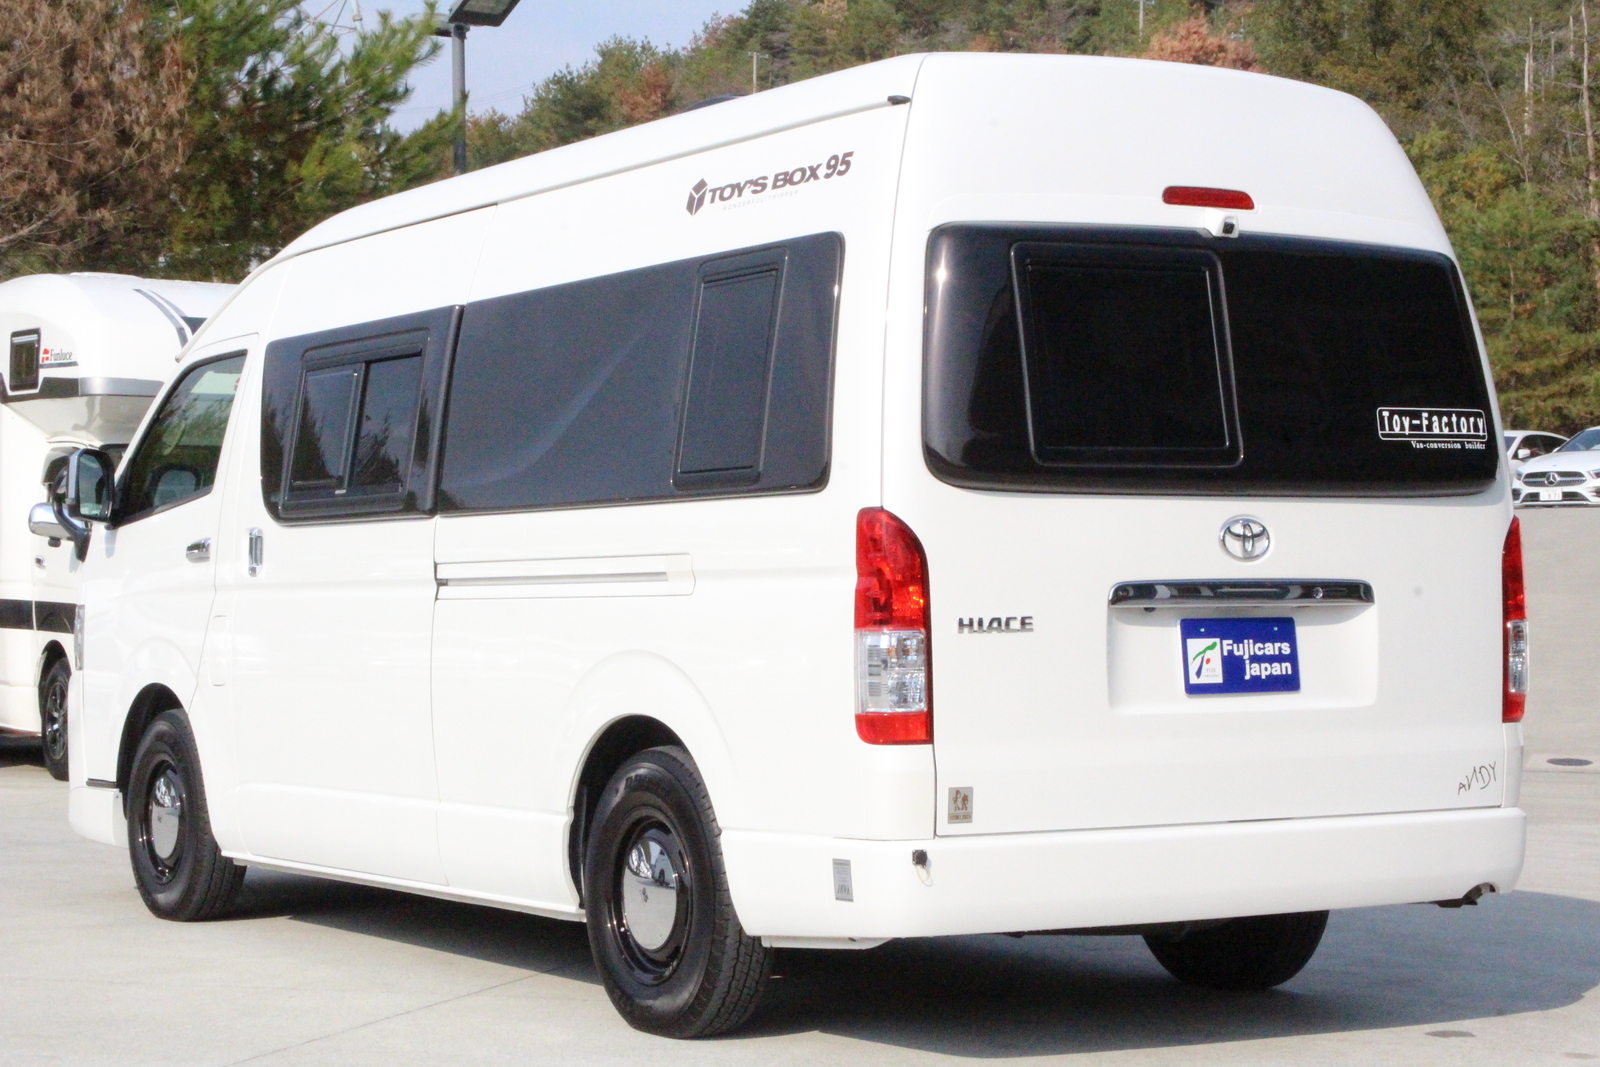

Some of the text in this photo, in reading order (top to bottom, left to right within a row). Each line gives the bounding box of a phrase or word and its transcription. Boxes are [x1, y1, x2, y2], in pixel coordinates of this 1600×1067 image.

[708, 150, 855, 205] TOY'S BOX 95
[1382, 411, 1484, 436] Toy-Factory
[1411, 440, 1486, 450] Van-conversion builder
[957, 616, 1034, 634] HIACE
[1222, 639, 1291, 660] Fujicars
[1244, 660, 1292, 680] japan
